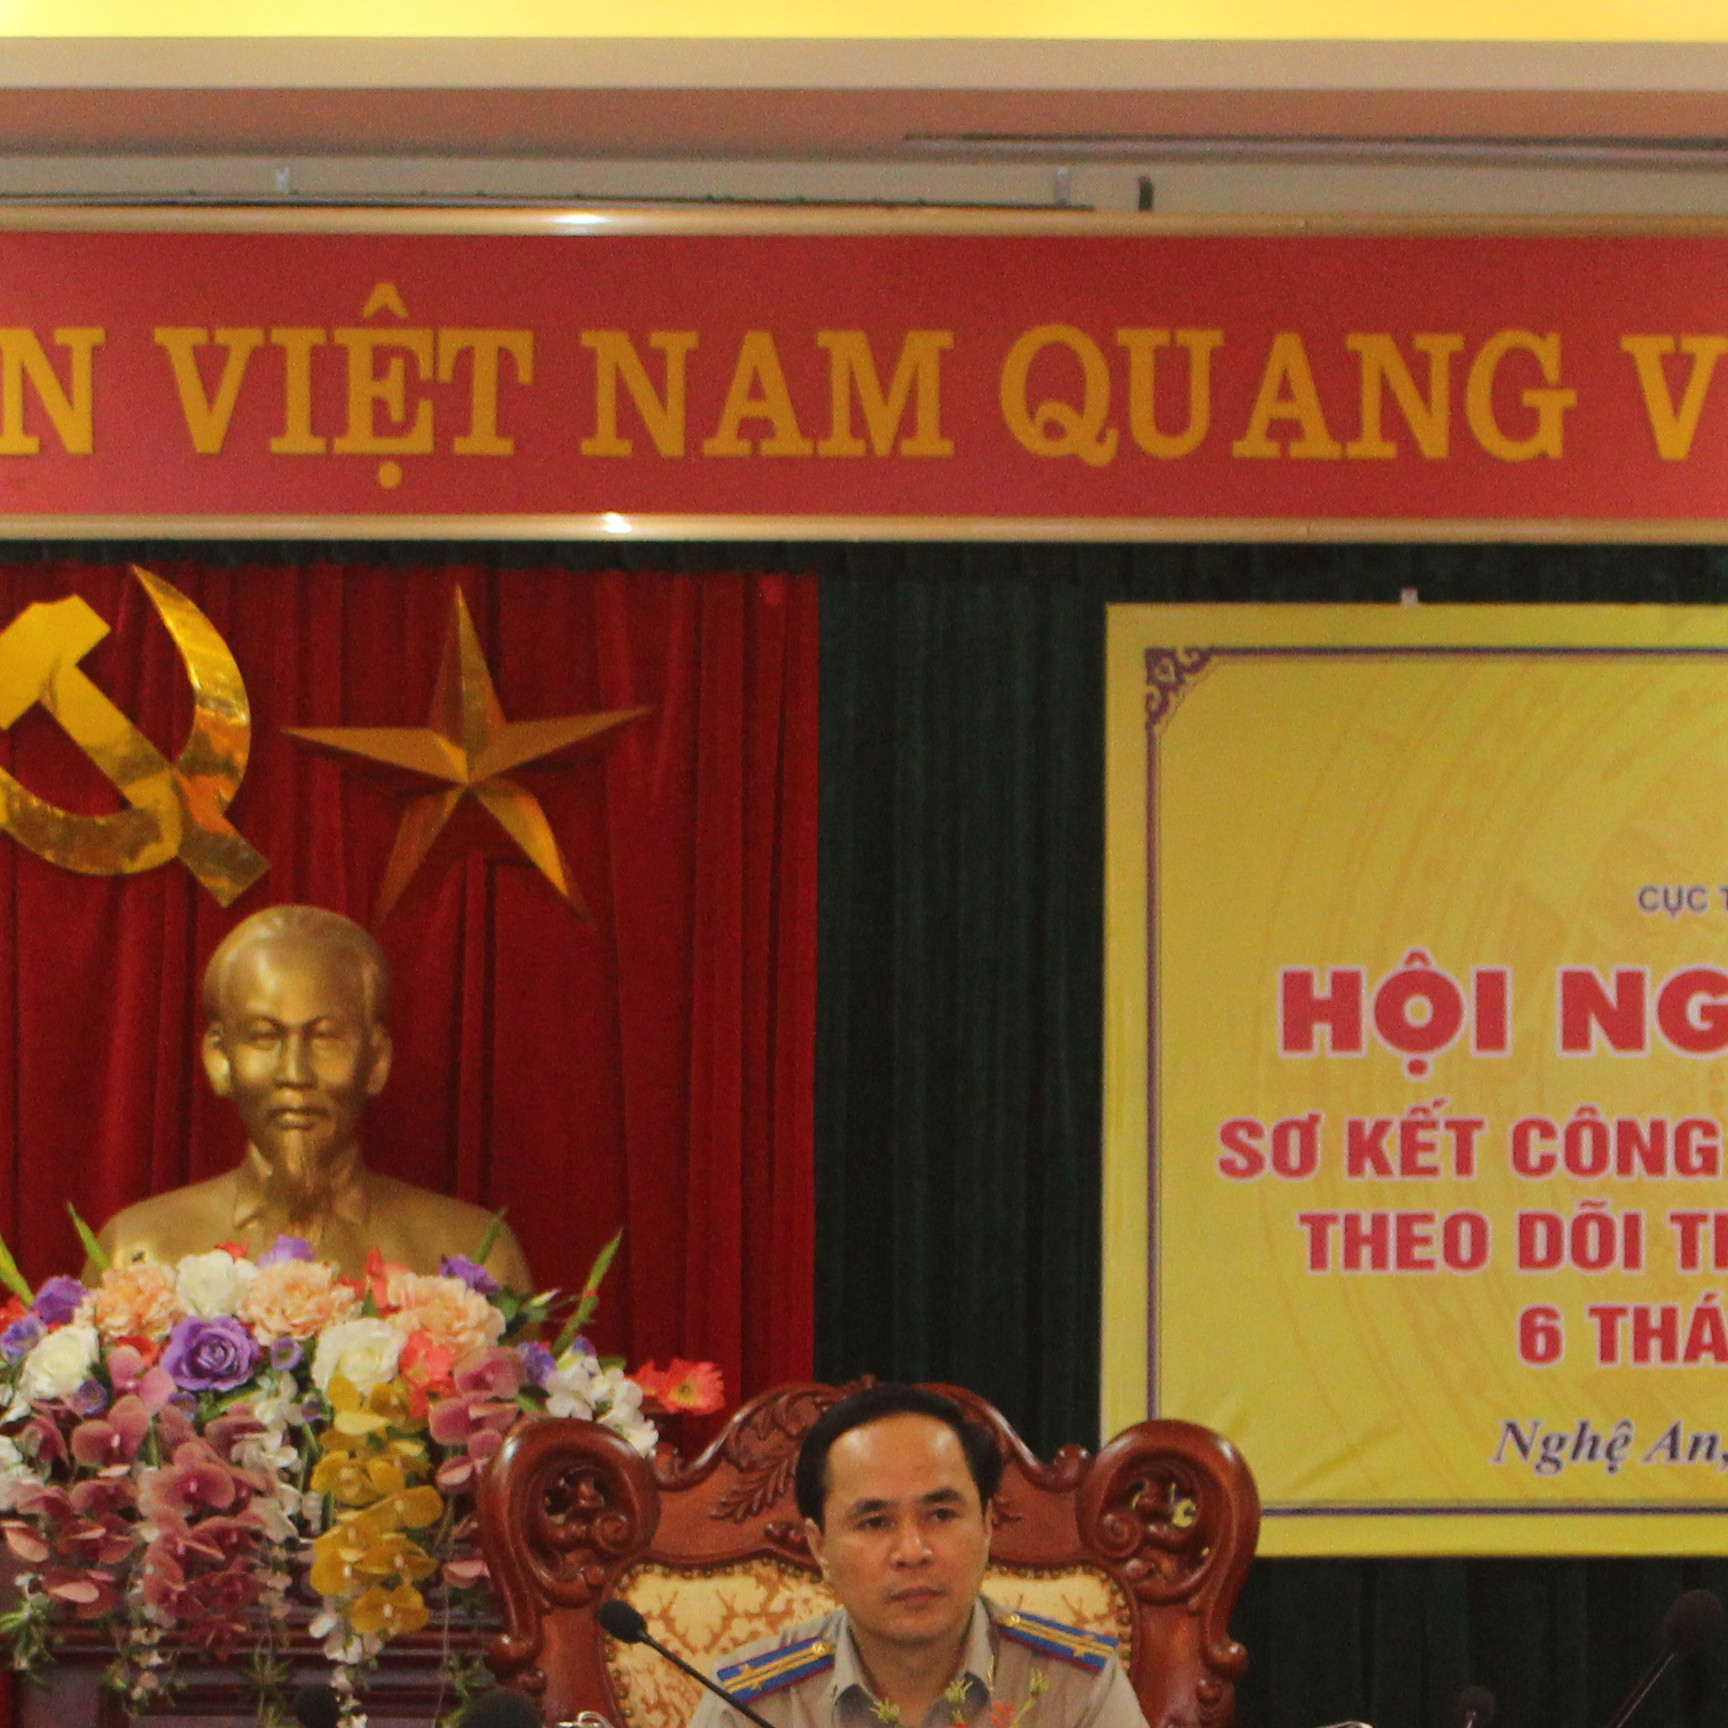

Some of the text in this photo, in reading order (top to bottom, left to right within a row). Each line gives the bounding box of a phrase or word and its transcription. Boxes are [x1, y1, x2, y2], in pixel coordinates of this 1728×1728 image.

[154, 283, 534, 488] VIỆT
[581, 328, 955, 458] NAM
[1001, 323, 1576, 466] QUANG
[1638, 885, 1709, 920] CỤC
[1280, 952, 1509, 1076] HỘI
[1218, 1112, 1320, 1178] SƠ
[1345, 1099, 1485, 1177] KẾT
[1511, 1107, 1720, 1177] CÔNG
[1297, 1211, 1490, 1272] THEO
[1516, 1199, 1643, 1272] DÕI
[1518, 1305, 1563, 1363] 6
[1490, 1418, 1635, 1478] Nghệ
